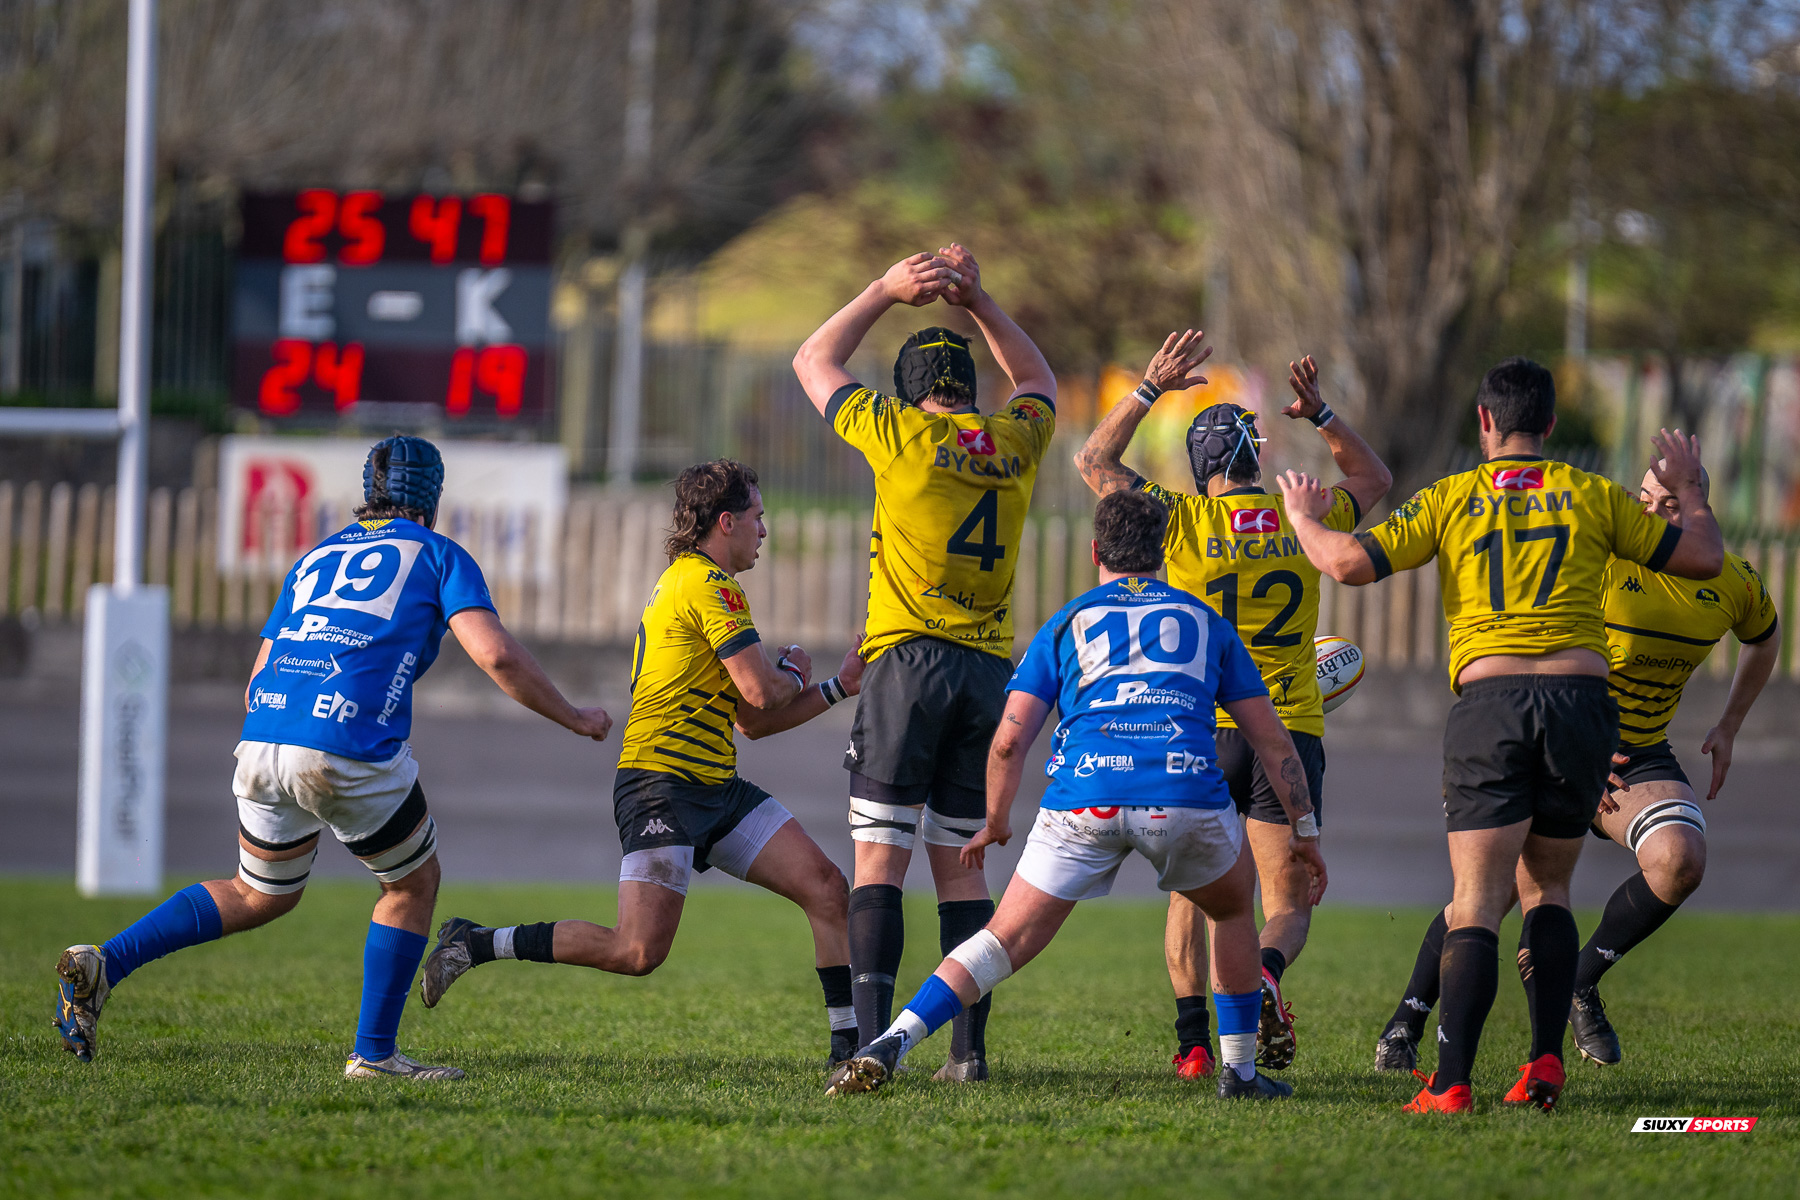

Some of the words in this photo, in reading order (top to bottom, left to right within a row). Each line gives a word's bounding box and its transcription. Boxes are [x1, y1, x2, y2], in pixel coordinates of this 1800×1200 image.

[283, 188, 386, 267] 25
[408, 193, 511, 267] 47
[279, 263, 337, 340] E
[454, 267, 512, 344] K
[258, 338, 365, 417] 24
[446, 344, 529, 419] 19
[934, 445, 1020, 479] BYCAM
[1468, 490, 1574, 517] BYCAM
[946, 489, 1005, 572] 4
[300, 544, 401, 605] 19
[1473, 524, 1570, 612] 17
[1206, 569, 1304, 648] 12
[321, 626, 374, 642] AUTO-CENTER
[1084, 608, 1199, 667] 10
[279, 656, 332, 670] Asturmine
[260, 692, 287, 705] INTEGRA
[1144, 688, 1197, 704] AUTO-CENTER
[1109, 721, 1172, 732] Asturmine
[1096, 755, 1134, 768] INTEGRA
